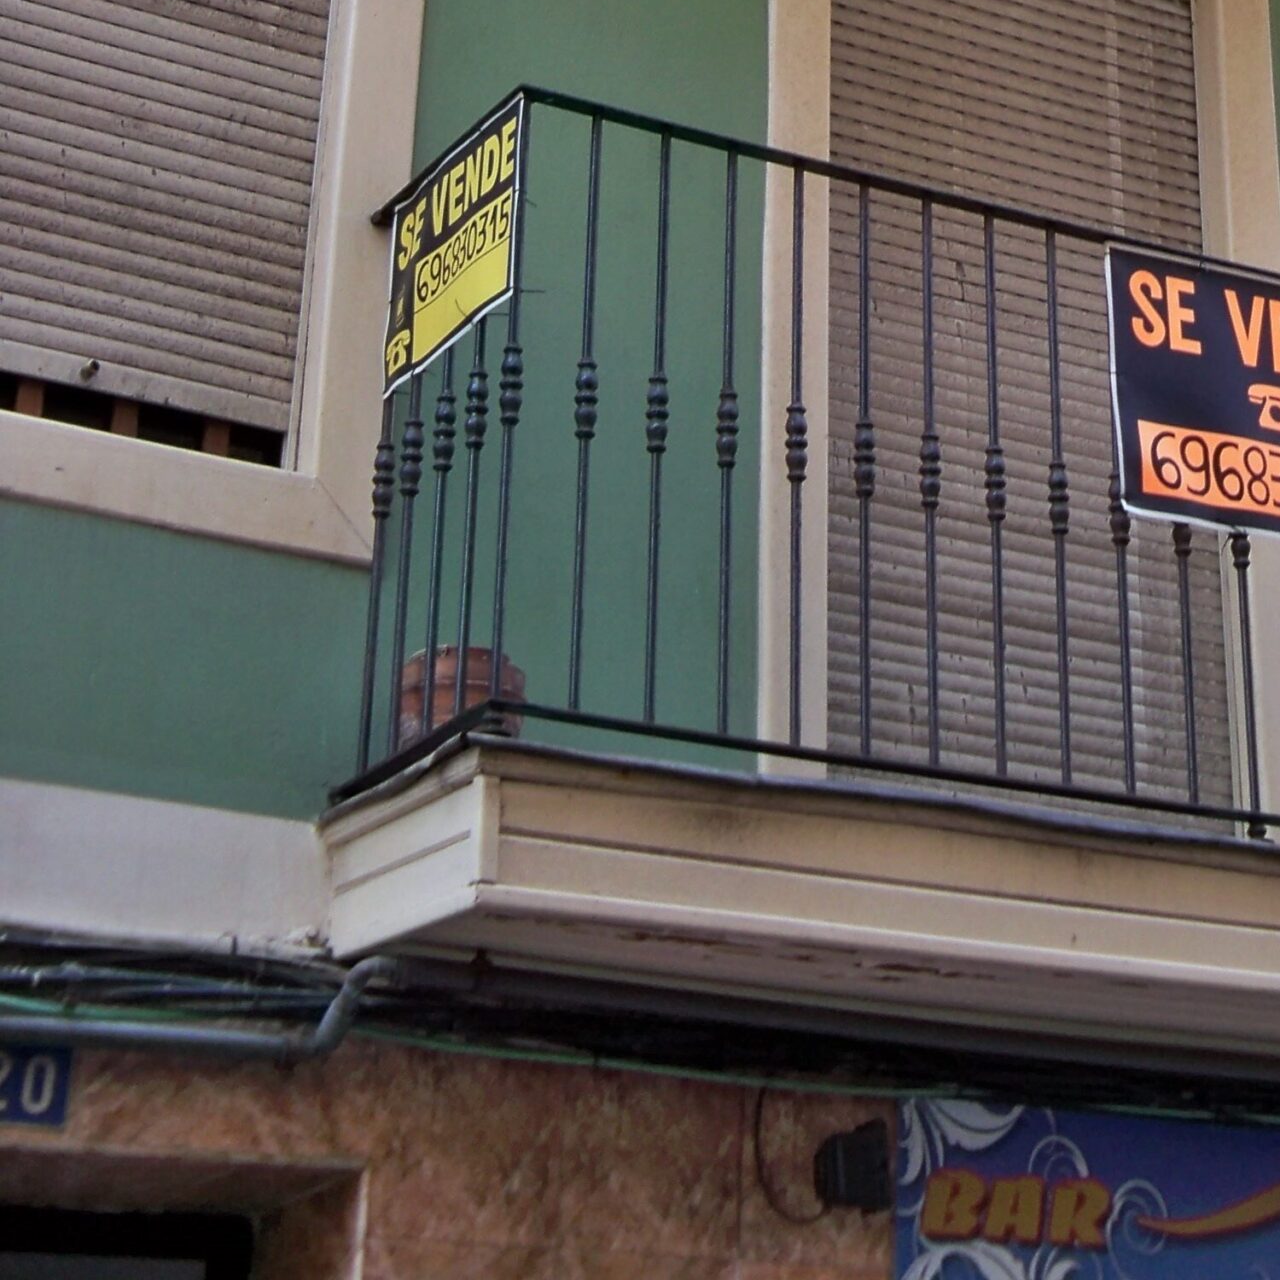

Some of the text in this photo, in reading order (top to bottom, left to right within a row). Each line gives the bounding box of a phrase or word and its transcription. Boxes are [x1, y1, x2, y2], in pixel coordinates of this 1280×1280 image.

[398, 116, 518, 270] SE VENDE
[416, 194, 511, 303] 696830315
[1129, 270, 1202, 355] SE
[920, 1167, 1113, 1248] BAR
